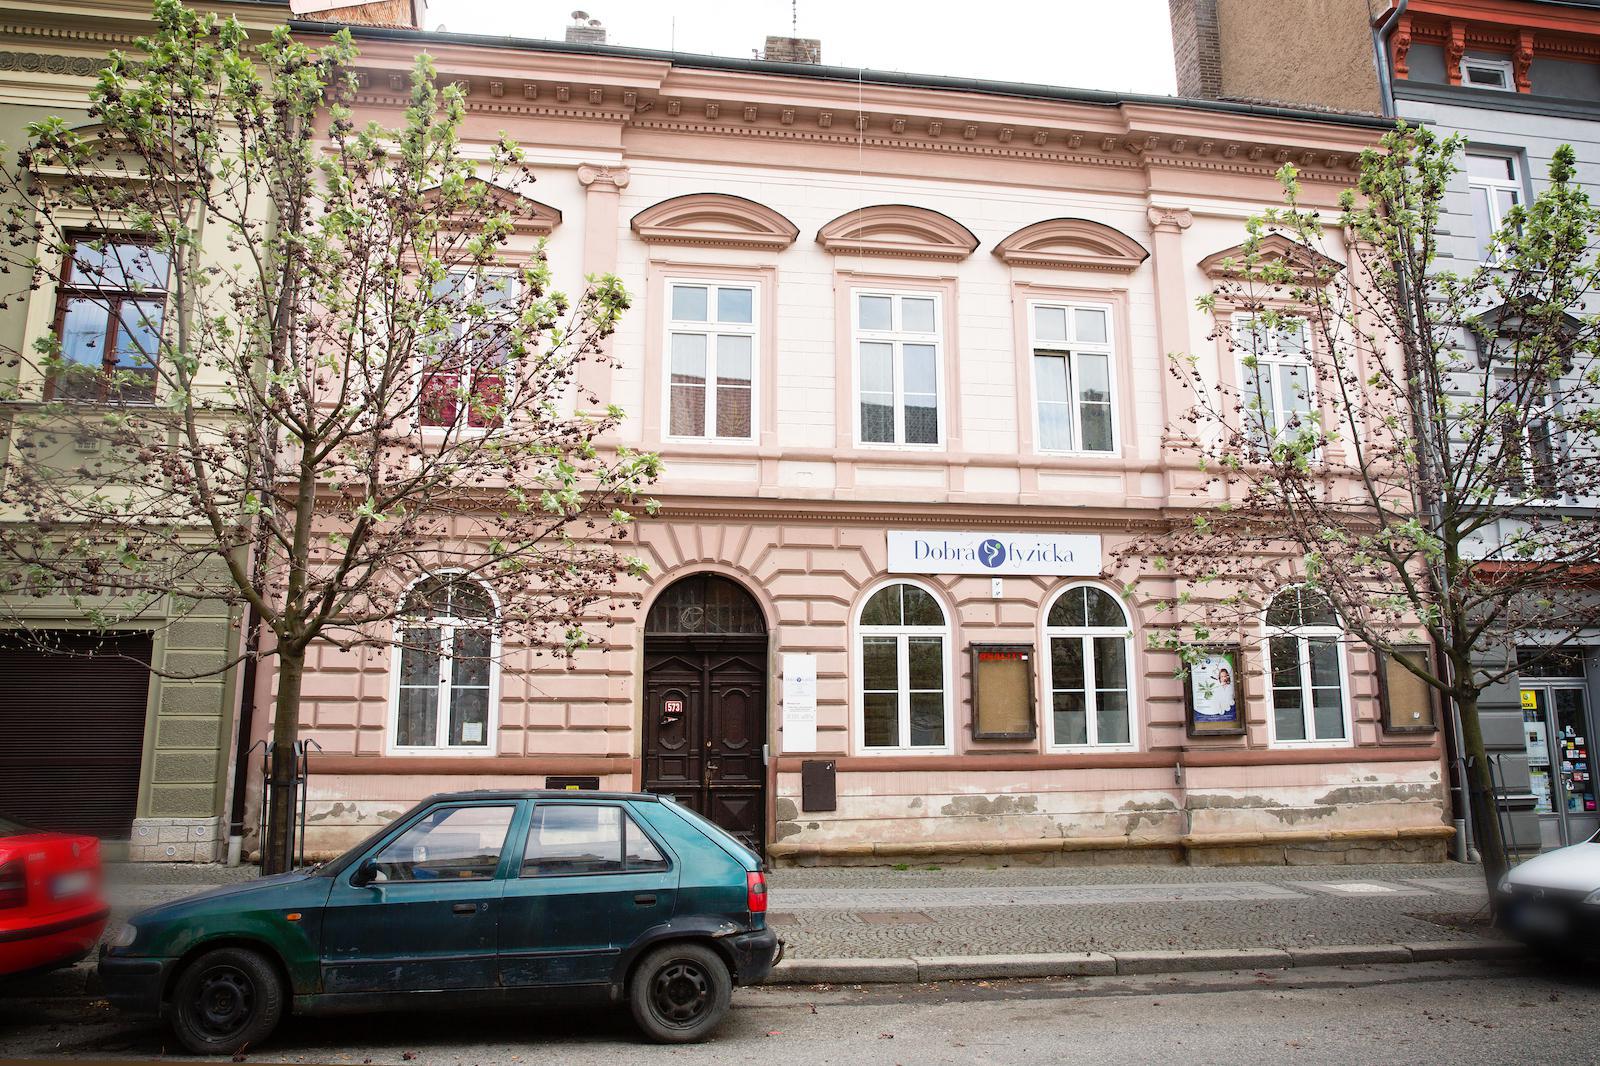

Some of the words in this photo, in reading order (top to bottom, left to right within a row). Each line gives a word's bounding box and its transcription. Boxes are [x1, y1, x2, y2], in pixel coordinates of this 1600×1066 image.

[914, 539, 976, 561] Dobrá
[1008, 542, 1074, 568] fyzička
[667, 702, 680, 712] 573
